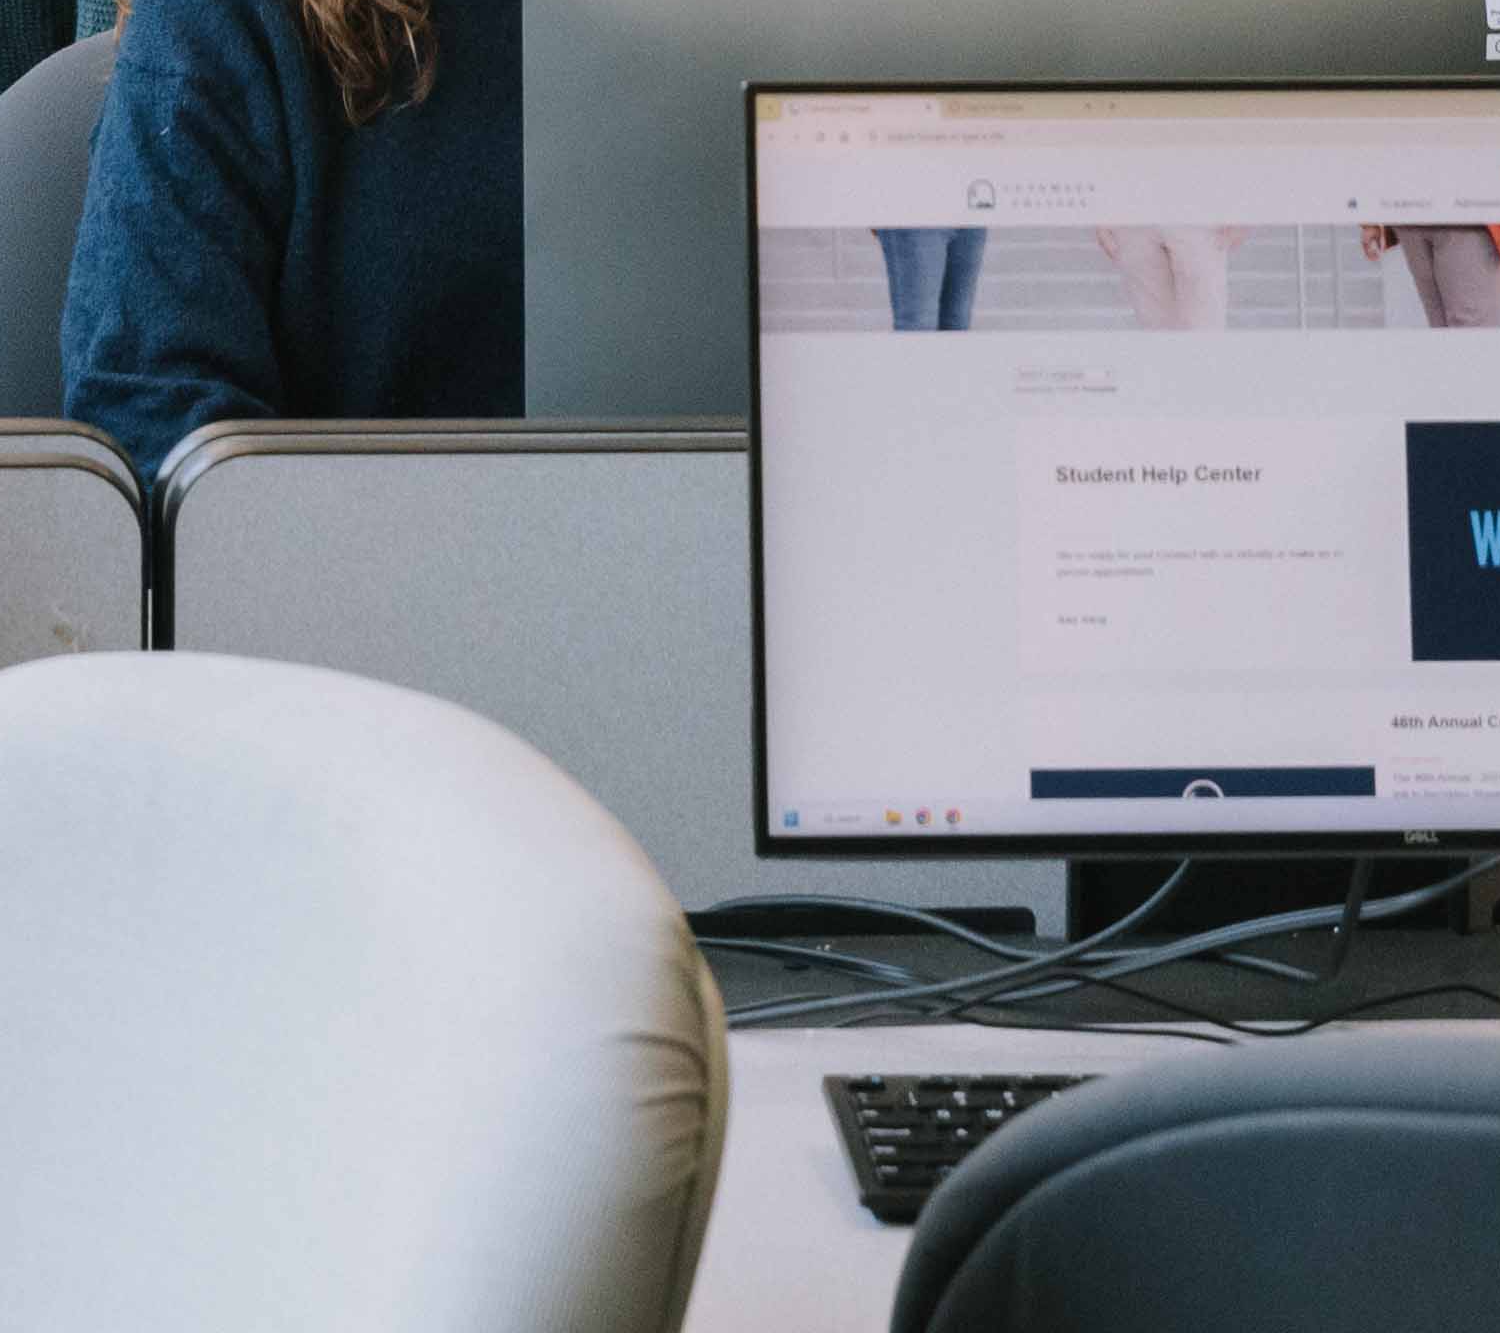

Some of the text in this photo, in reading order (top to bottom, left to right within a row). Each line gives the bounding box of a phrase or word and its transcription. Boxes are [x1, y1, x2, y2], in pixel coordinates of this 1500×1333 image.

[1055, 463, 1263, 486] Student Help Center
[1427, 714, 1482, 730] Annual
